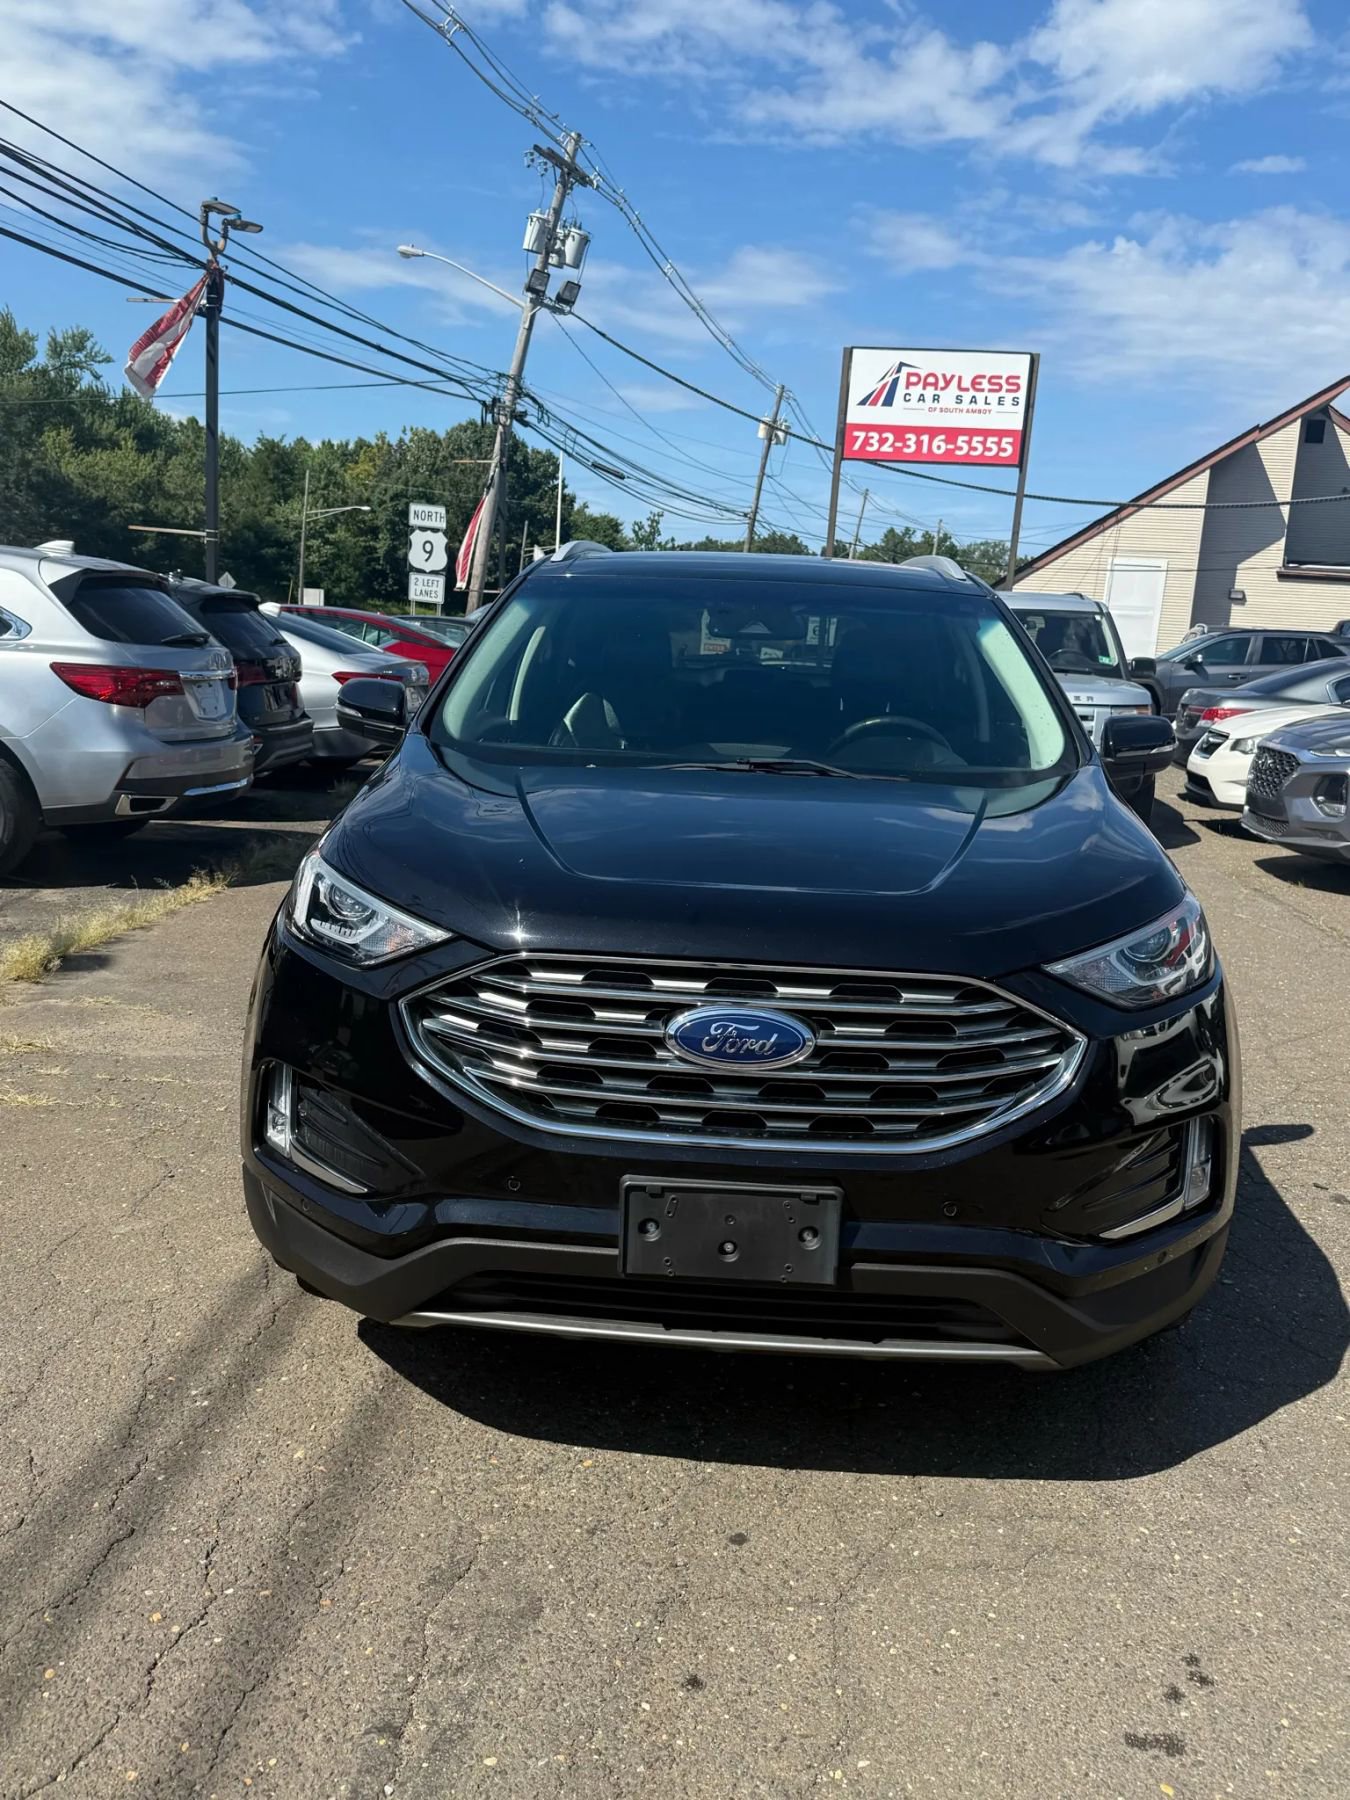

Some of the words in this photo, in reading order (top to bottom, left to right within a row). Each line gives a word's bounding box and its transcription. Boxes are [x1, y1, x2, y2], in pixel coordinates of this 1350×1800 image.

[904, 371, 1021, 393] PAYLESS
[903, 393, 940, 404] CAR
[955, 395, 1020, 406] SALES
[851, 431, 1014, 457] 732-316-5555
[413, 509, 445, 522] NORTH
[422, 540, 434, 562] 9
[414, 577, 420, 587] 2
[422, 578, 440, 588] LEFT
[414, 588, 439, 599] LANES
[701, 1021, 779, 1056] Ford
